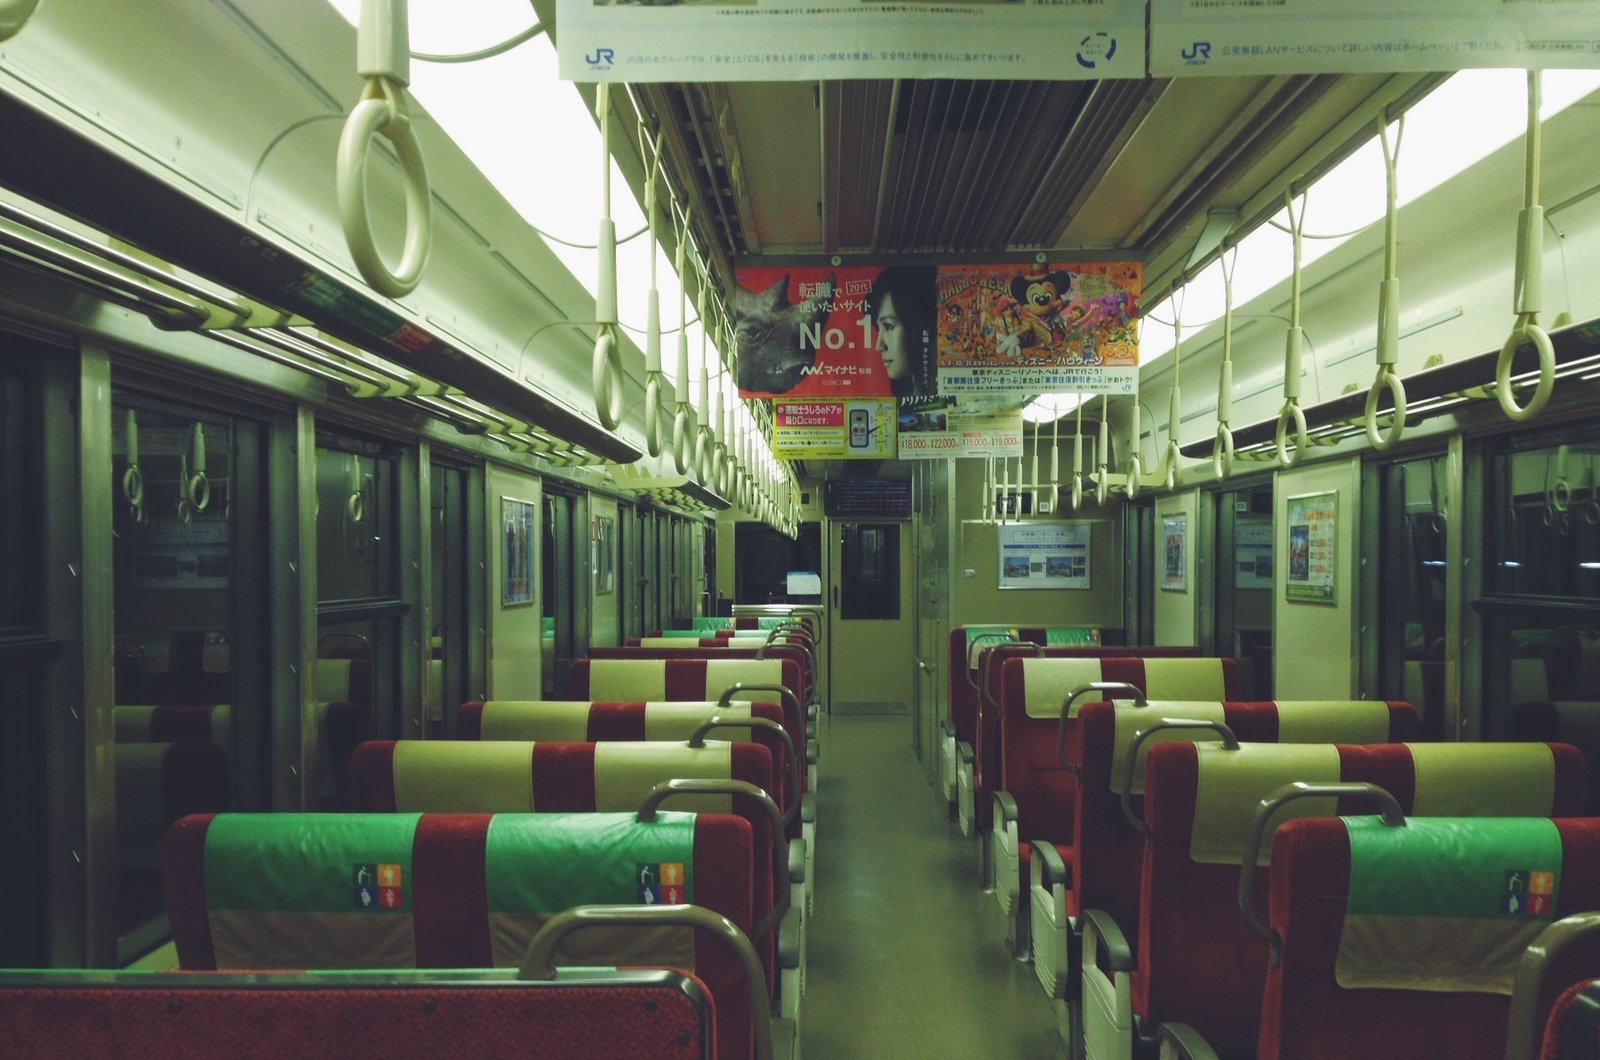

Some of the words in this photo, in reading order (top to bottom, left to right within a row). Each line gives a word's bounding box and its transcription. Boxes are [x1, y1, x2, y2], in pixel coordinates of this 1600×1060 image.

[585, 48, 614, 65] JR
[1181, 42, 1211, 59] JR
[798, 281, 843, 299] 転職で
[848, 282, 869, 293] 20代
[799, 299, 872, 313] 使いたいサイト
[799, 314, 872, 350] No.1
[824, 365, 857, 375] マイナビ
